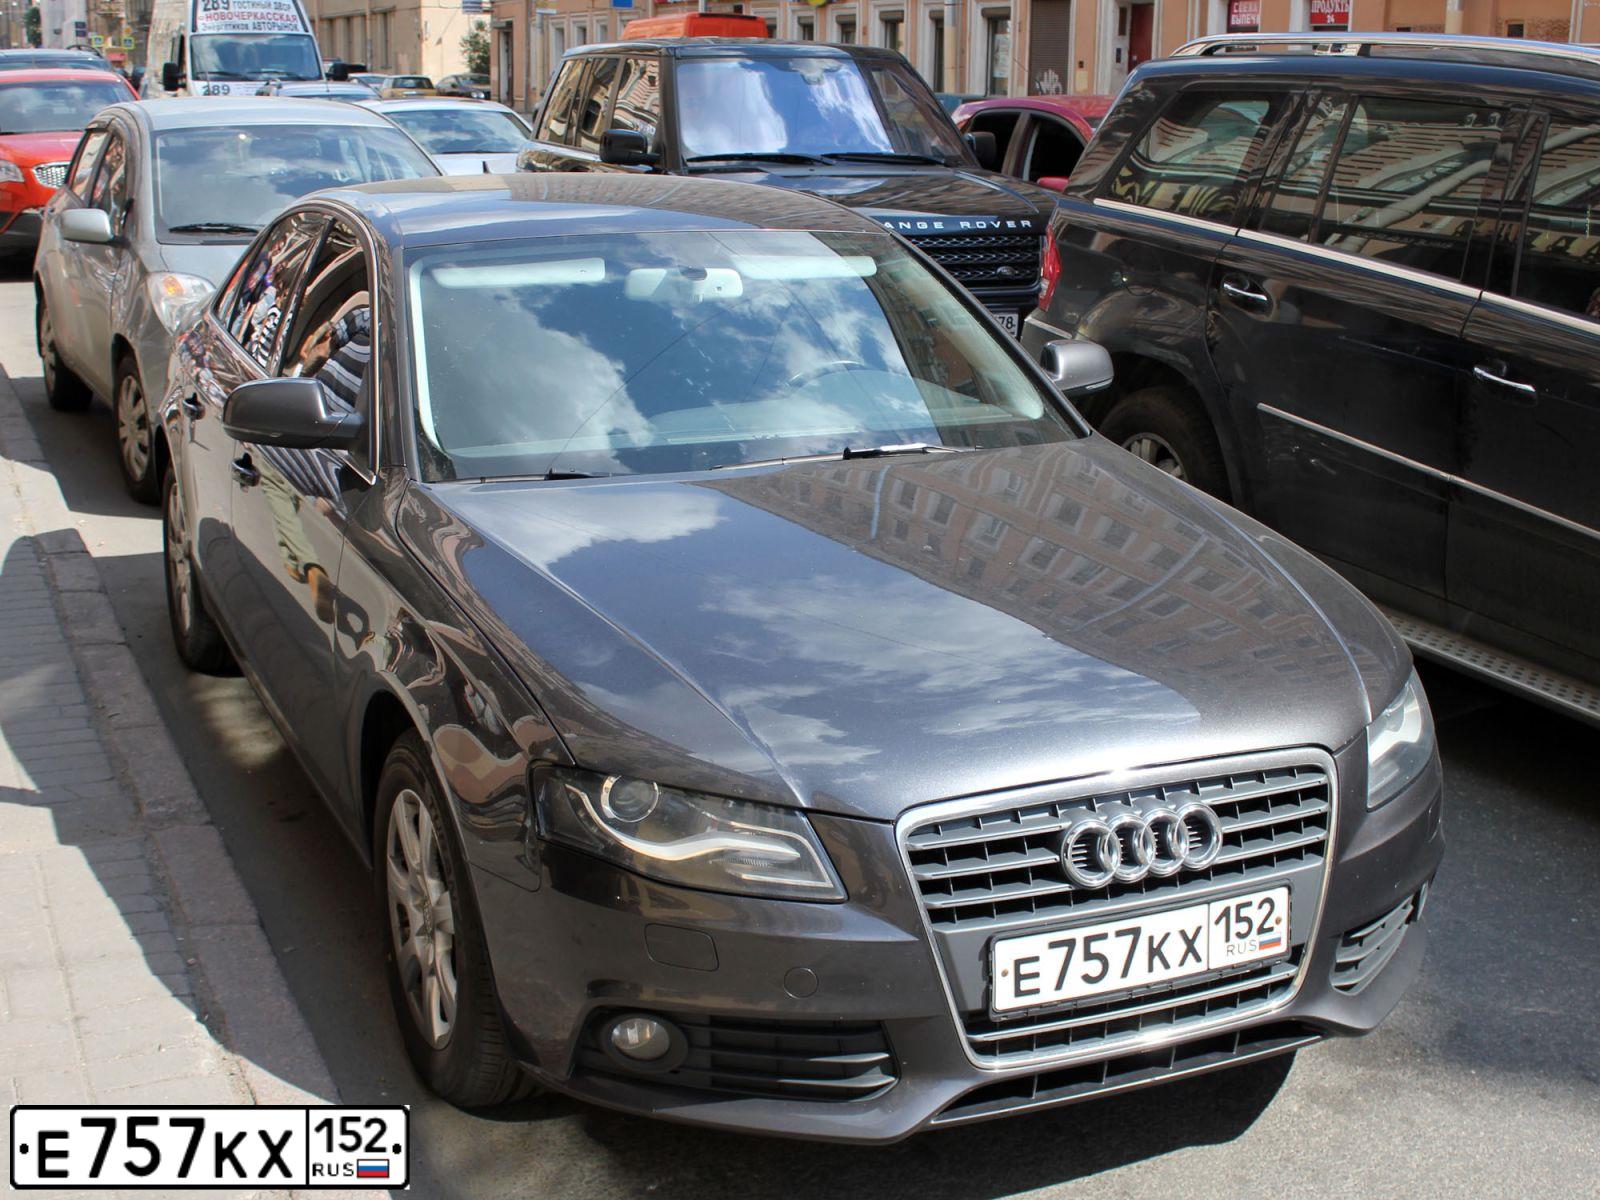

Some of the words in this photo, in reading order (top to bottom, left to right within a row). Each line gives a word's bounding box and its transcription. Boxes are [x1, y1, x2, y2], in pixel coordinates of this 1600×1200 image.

[203, 0, 230, 11] 289
[205, 11, 298, 23] НОВОЧЕРКАССКАЯ
[252, 22, 300, 32] АВТОРЫНОК
[202, 84, 231, 96] 289
[883, 221, 945, 230] ANGE
[959, 220, 1032, 229] ROVER
[1214, 896, 1275, 943] 152
[1225, 938, 1257, 957] RUS
